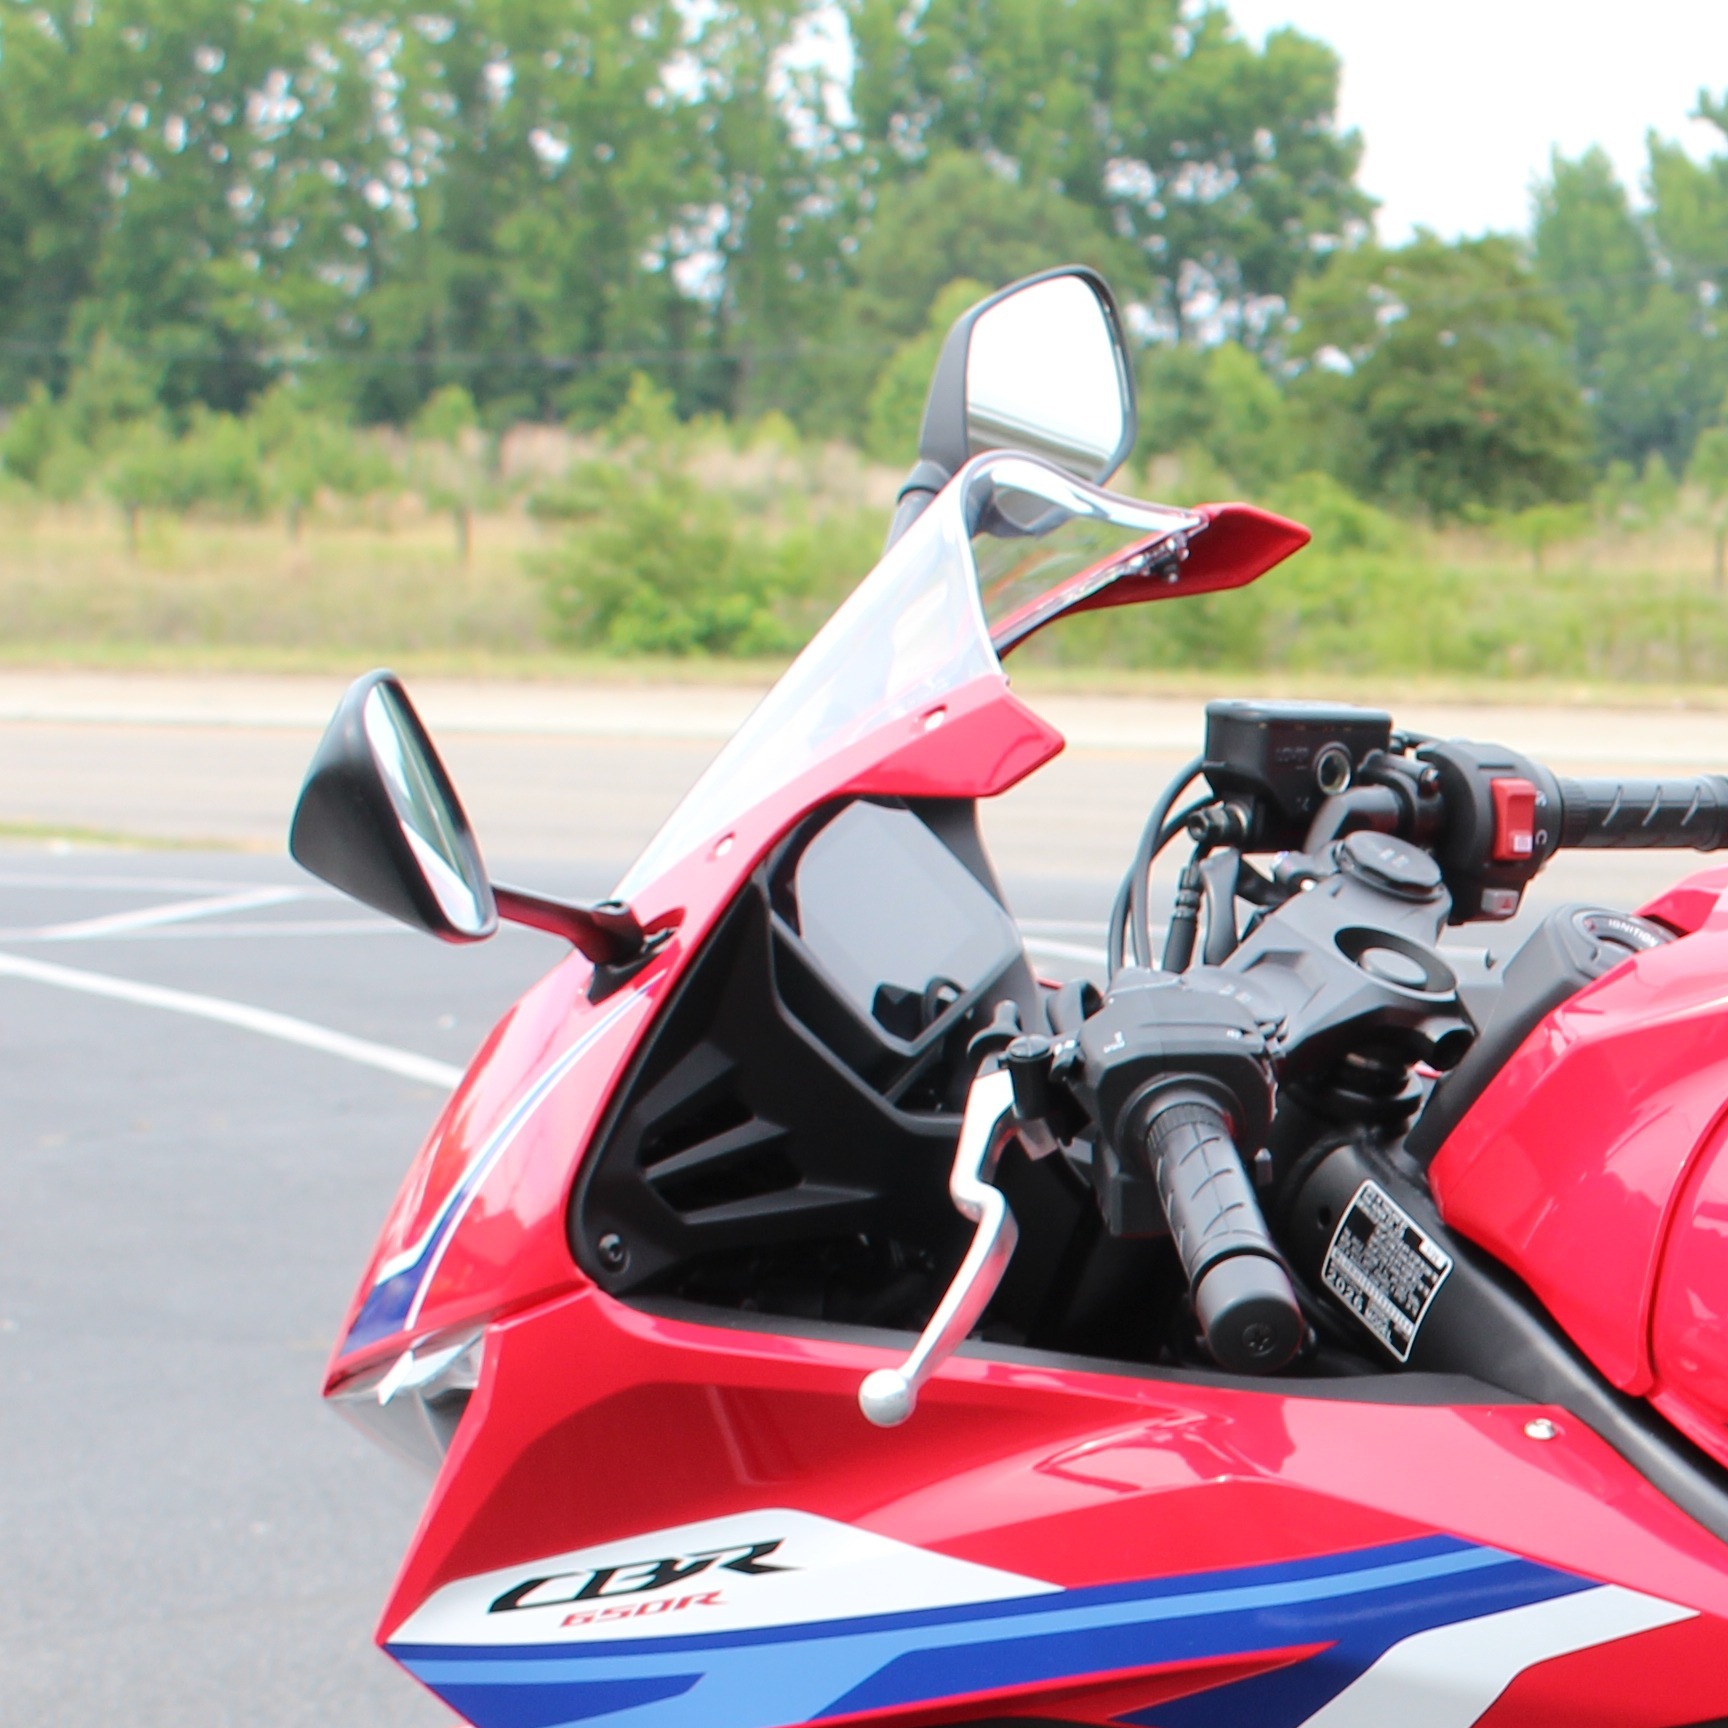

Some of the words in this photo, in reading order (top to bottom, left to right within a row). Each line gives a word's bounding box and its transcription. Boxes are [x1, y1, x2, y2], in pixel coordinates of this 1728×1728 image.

[1608, 918, 1658, 947] IGNITION
[488, 1537, 803, 1613] CBR
[560, 1590, 728, 1628] 650R
